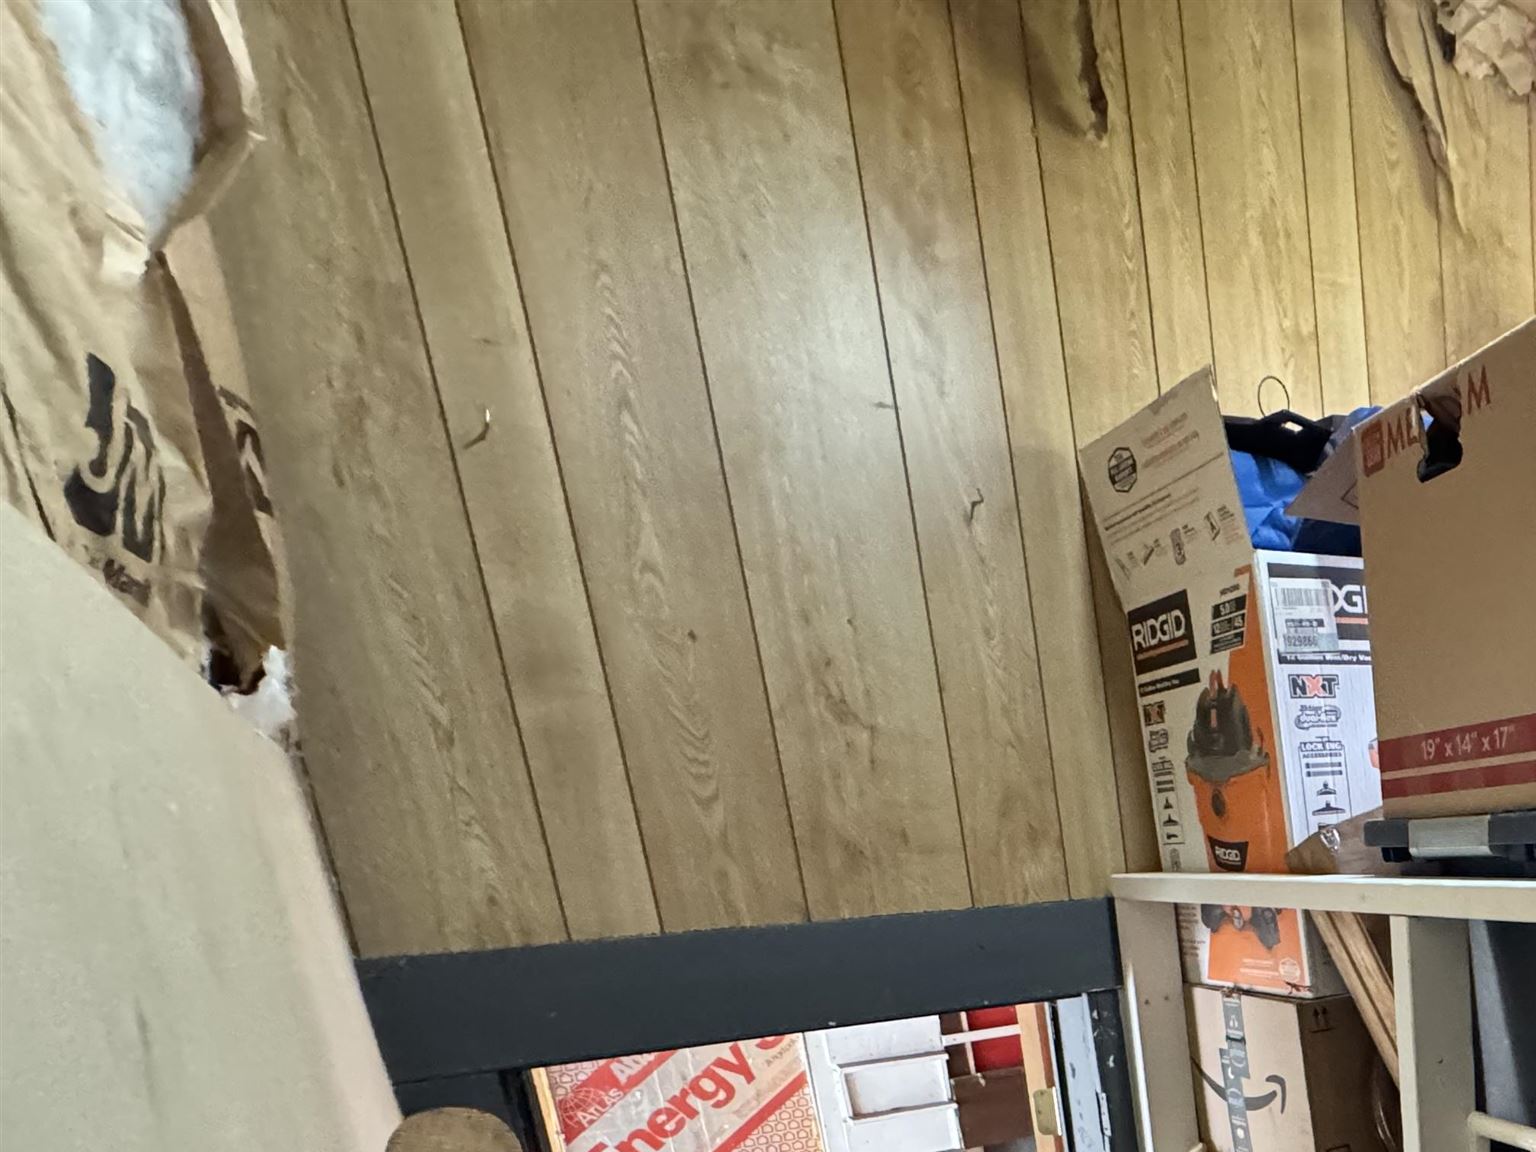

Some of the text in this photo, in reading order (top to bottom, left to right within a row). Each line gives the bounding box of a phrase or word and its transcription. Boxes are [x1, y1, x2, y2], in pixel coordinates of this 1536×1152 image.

[1131, 608, 1186, 652] RIDGID
[1289, 675, 1338, 698] NXT
[1421, 736, 1440, 760] 19"
[1455, 732, 1478, 754] 14"
